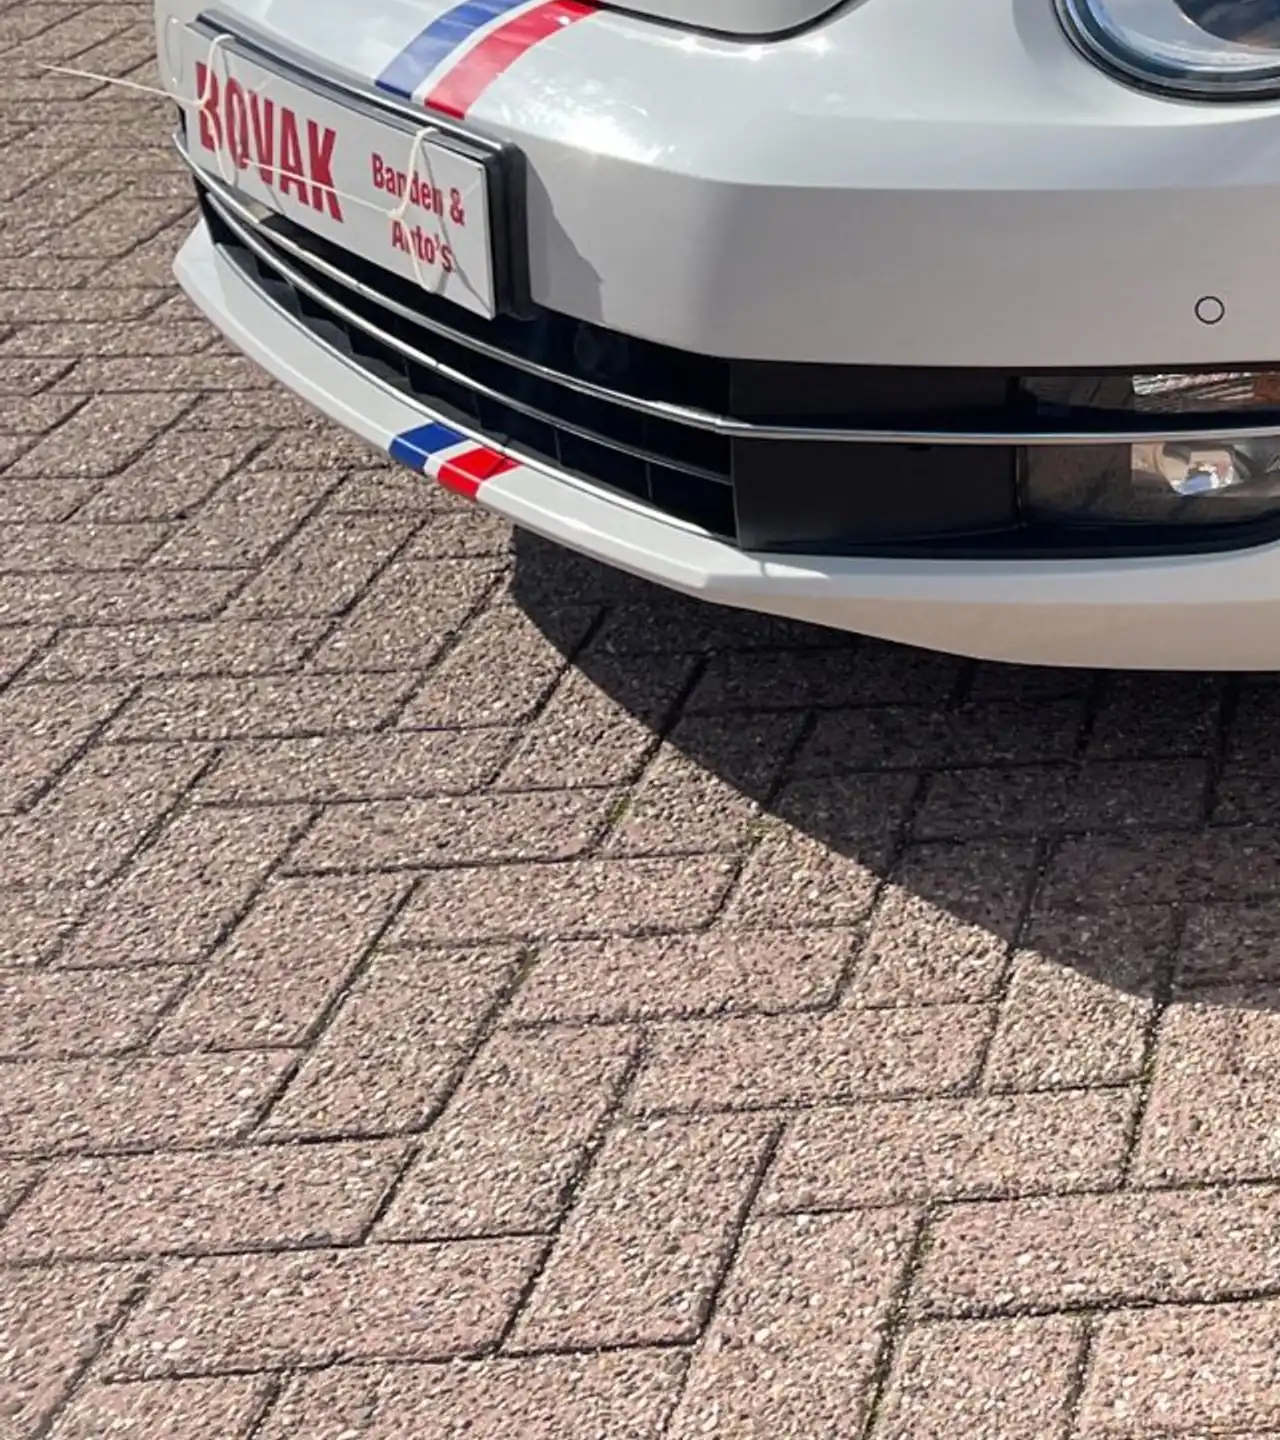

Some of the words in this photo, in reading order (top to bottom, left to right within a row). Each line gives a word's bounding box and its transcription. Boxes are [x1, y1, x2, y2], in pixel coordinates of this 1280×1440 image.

[195, 60, 345, 223] BOVAK
[371, 152, 443, 217] Banden
[450, 187, 465, 227] &
